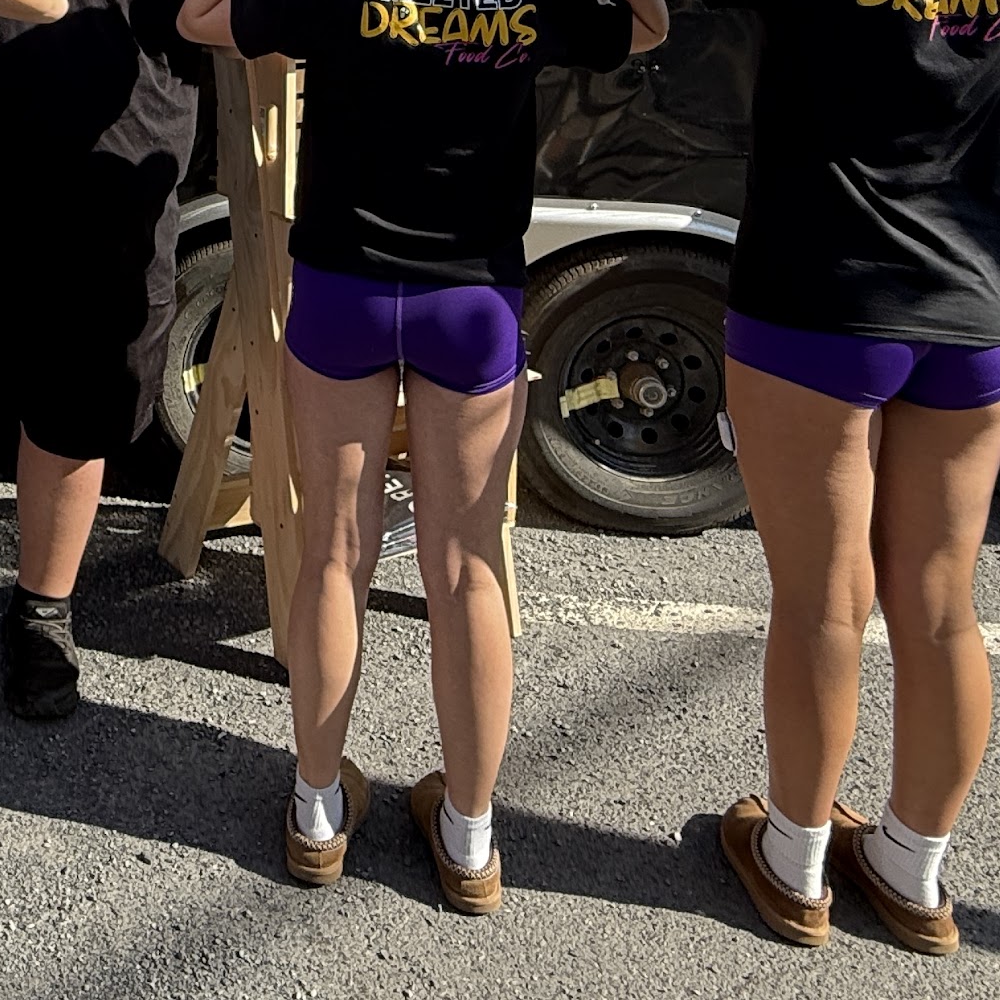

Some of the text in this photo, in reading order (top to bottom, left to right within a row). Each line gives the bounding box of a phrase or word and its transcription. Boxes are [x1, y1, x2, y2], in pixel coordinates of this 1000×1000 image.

[360, 0, 537, 47] DREAMS
[434, 42, 531, 69] Food Co.
